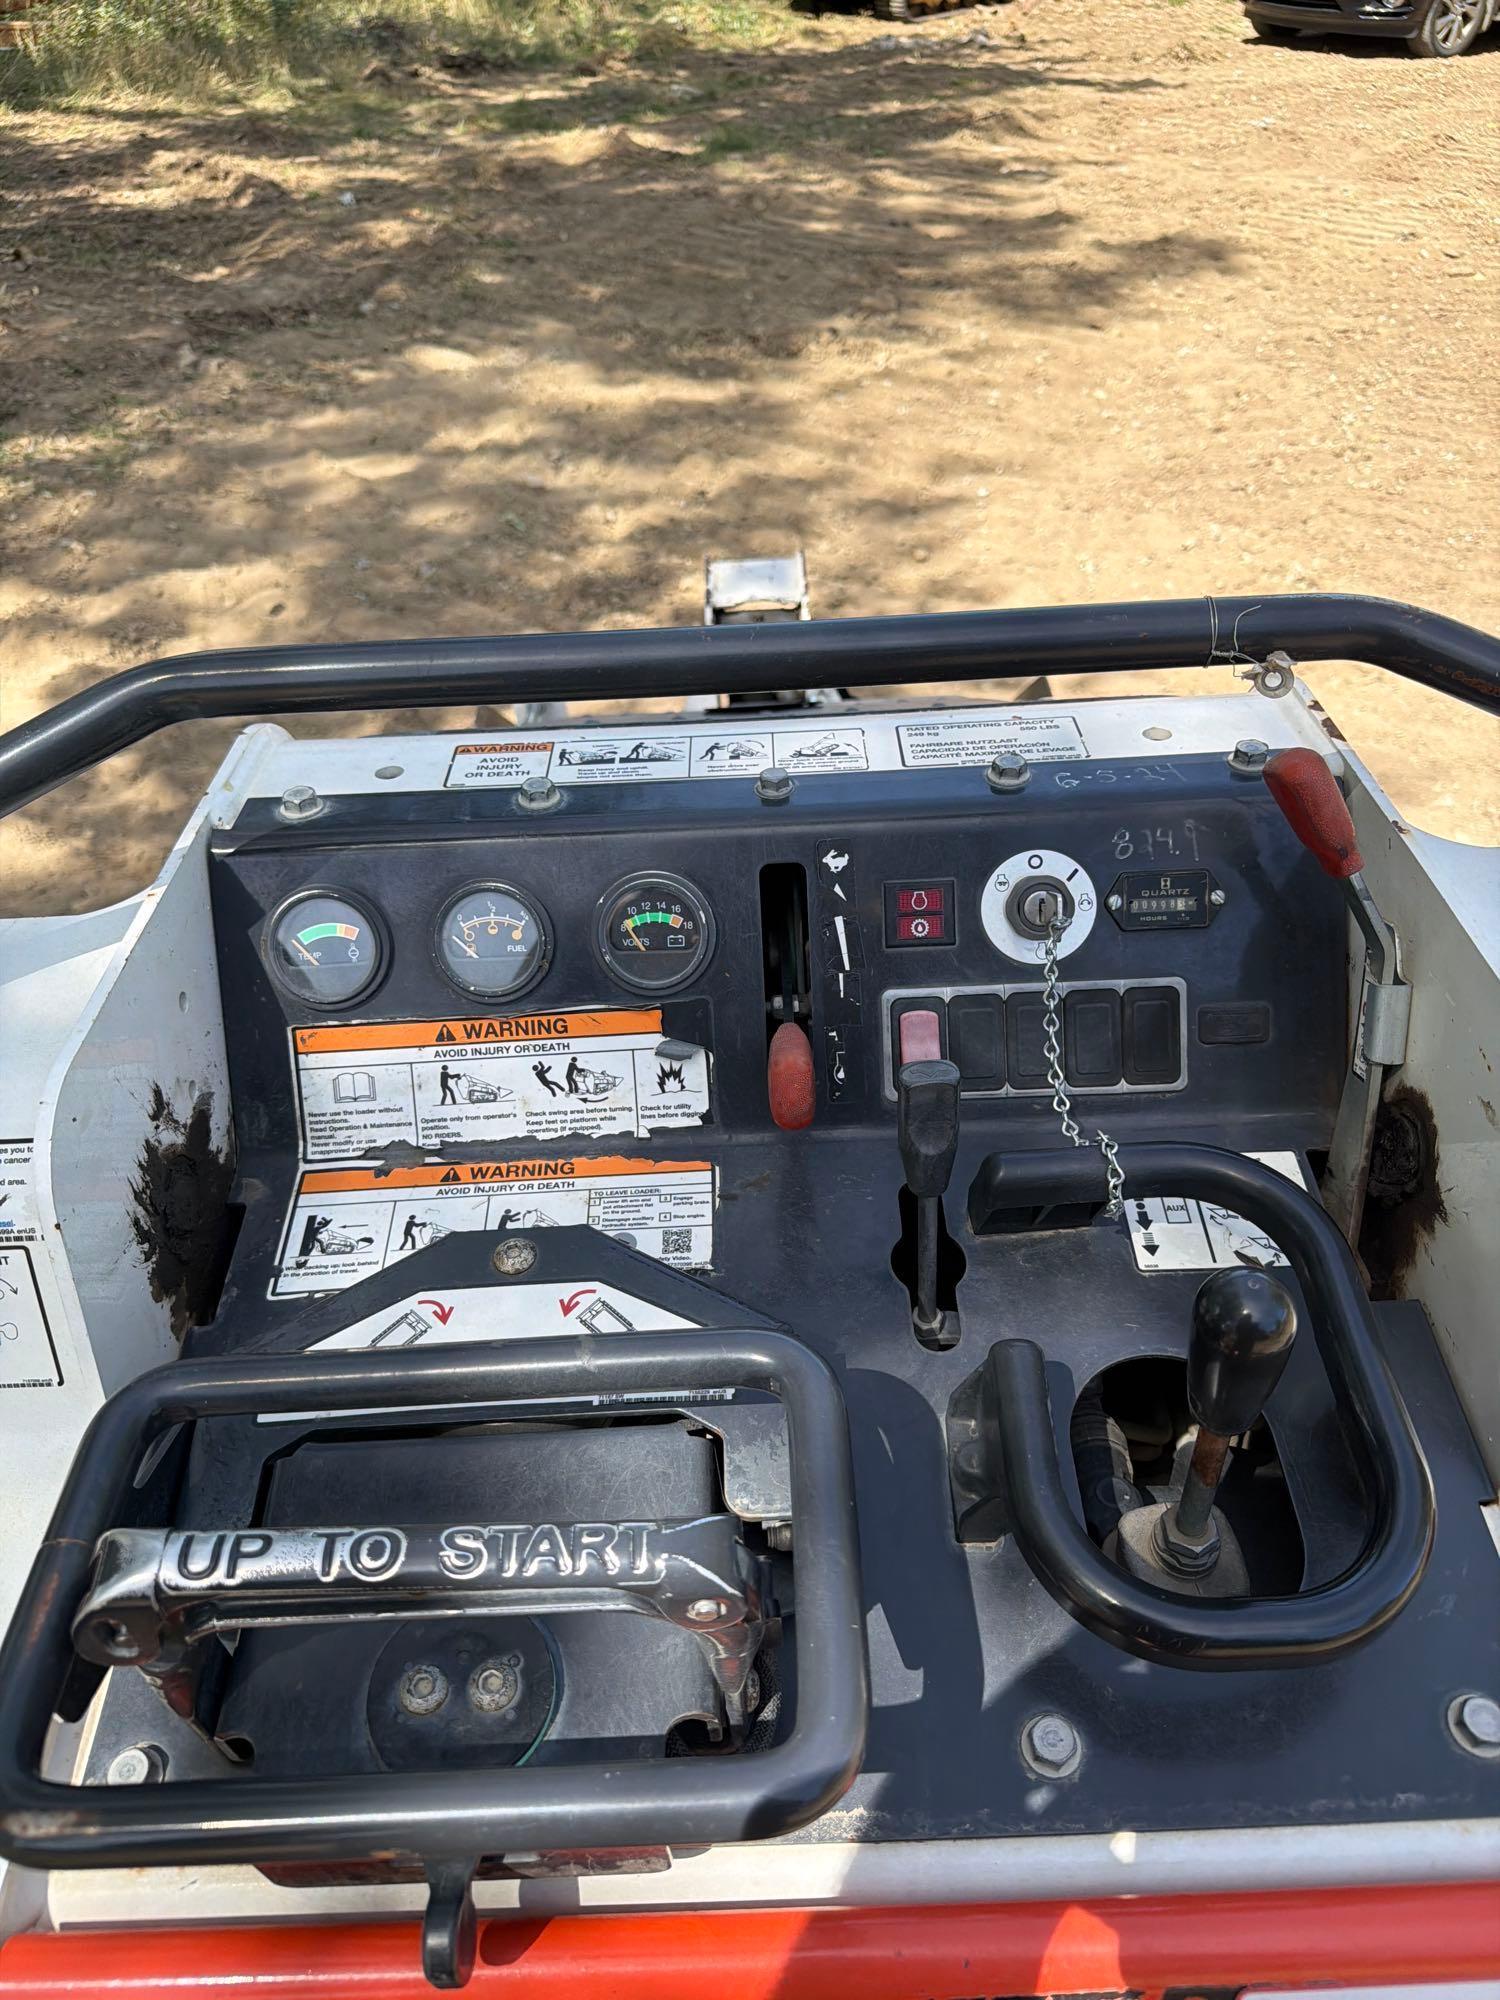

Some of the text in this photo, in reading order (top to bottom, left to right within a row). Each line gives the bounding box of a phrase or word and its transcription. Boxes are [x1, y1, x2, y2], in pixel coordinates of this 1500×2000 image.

[943, 722, 1002, 731] OPERATING
[1004, 719, 1056, 727] CAPACITY
[473, 743, 548, 753] WARNING
[909, 737, 1019, 748] FAHRBARE NUTZLAST
[911, 746, 970, 754] CAPACIDAD
[989, 741, 1051, 750] OPERACIÓN
[912, 752, 963, 760] CAPACITÉ
[1141, 889, 1190, 897] QUARTZ
[627, 907, 637, 915] 10
[641, 902, 651, 910] 12
[656, 901, 666, 909] 14
[671, 905, 681, 913] 16
[683, 921, 693, 930] 18
[462, 1018, 569, 1040] WARNING
[434, 1042, 570, 1059] AVOID INJURY OR DEATH
[483, 1112, 517, 1120] operator's
[548, 1109, 568, 1117] swing
[329, 1124, 361, 1132] Operation
[370, 1121, 413, 1129] Maintenance
[527, 1126, 558, 1134] operating
[10, 1146, 25, 1155] you
[470, 1161, 575, 1180] WARNING
[436, 1181, 575, 1196] AVOID INJURY OR DEATH
[1166, 1204, 1186, 1212] AUX
[176, 1522, 661, 1582] UP TO START
